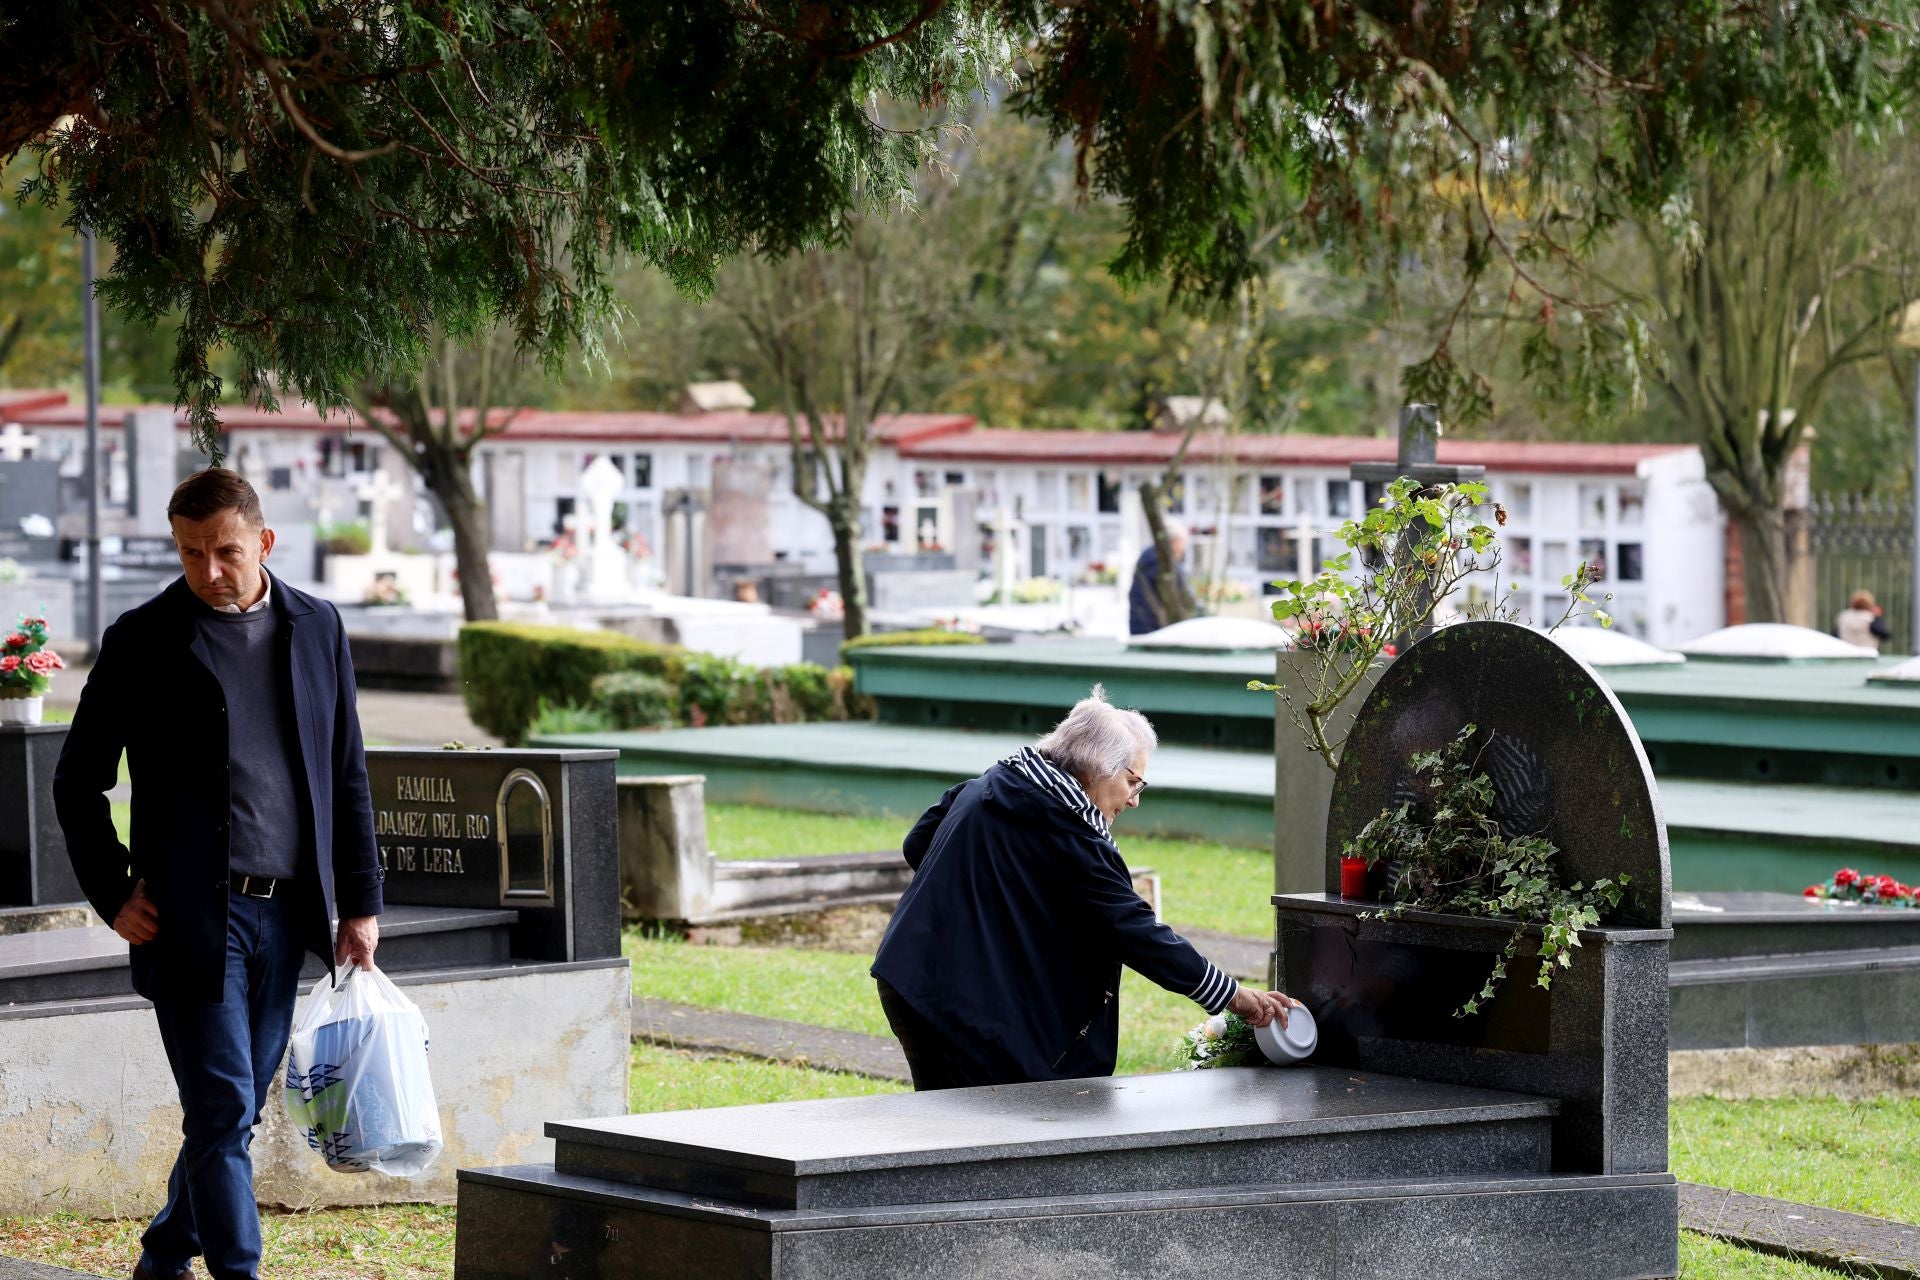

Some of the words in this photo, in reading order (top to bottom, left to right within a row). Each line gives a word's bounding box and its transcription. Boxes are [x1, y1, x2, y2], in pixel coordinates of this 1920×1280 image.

[397, 776, 456, 803] FAMILIA
[432, 813, 461, 838] DEL
[466, 814, 490, 839] RIO
[380, 846, 391, 871] Y
[397, 847, 416, 871] DE
[422, 847, 465, 874] LERA
